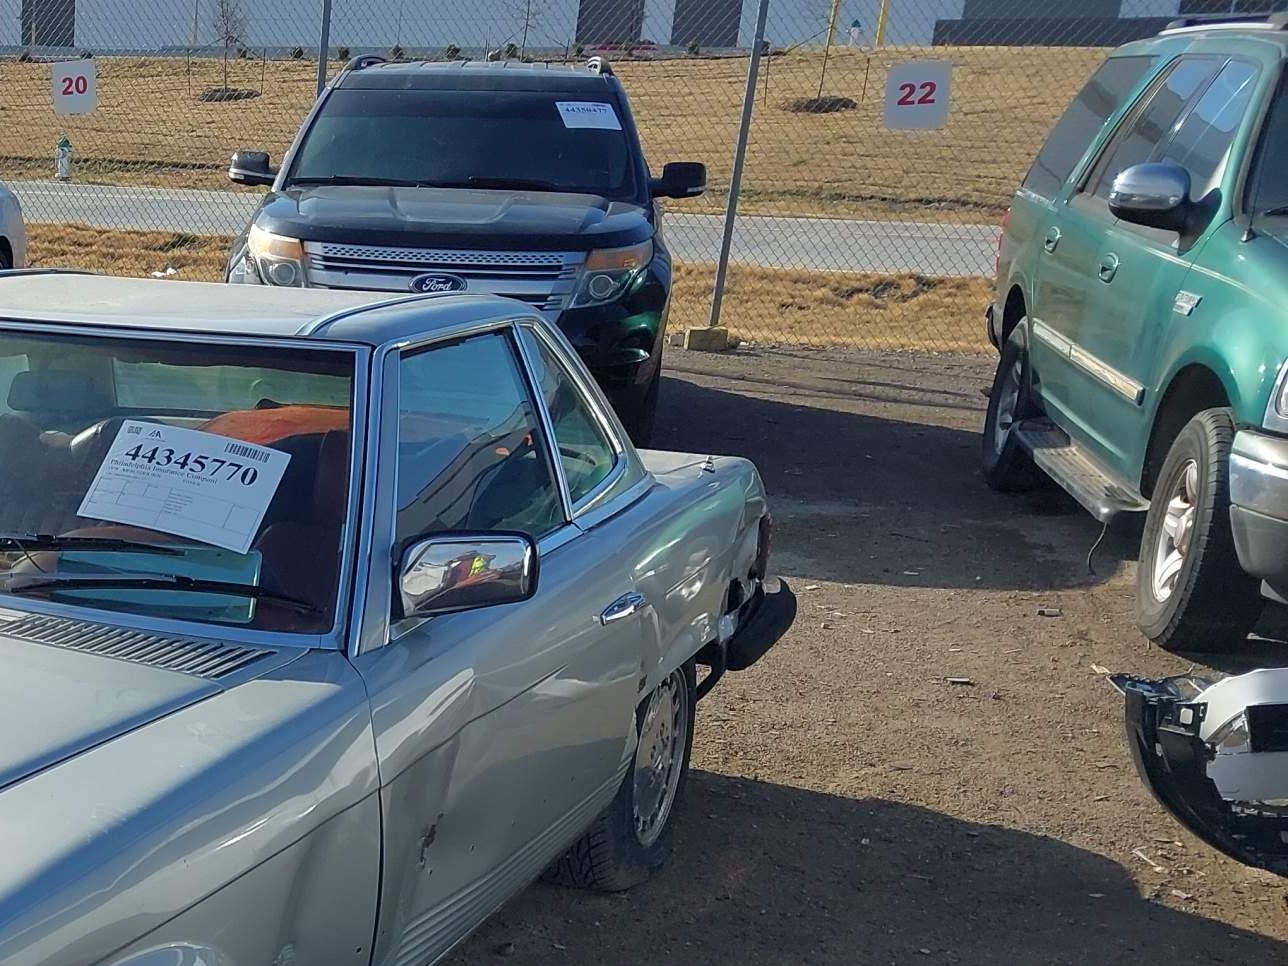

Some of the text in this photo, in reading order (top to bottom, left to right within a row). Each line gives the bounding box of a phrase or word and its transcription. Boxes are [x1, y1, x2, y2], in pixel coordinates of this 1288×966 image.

[62, 76, 88, 96] 20
[897, 82, 937, 106] 22
[422, 277, 453, 291] Ford
[125, 443, 258, 486] 44345770
